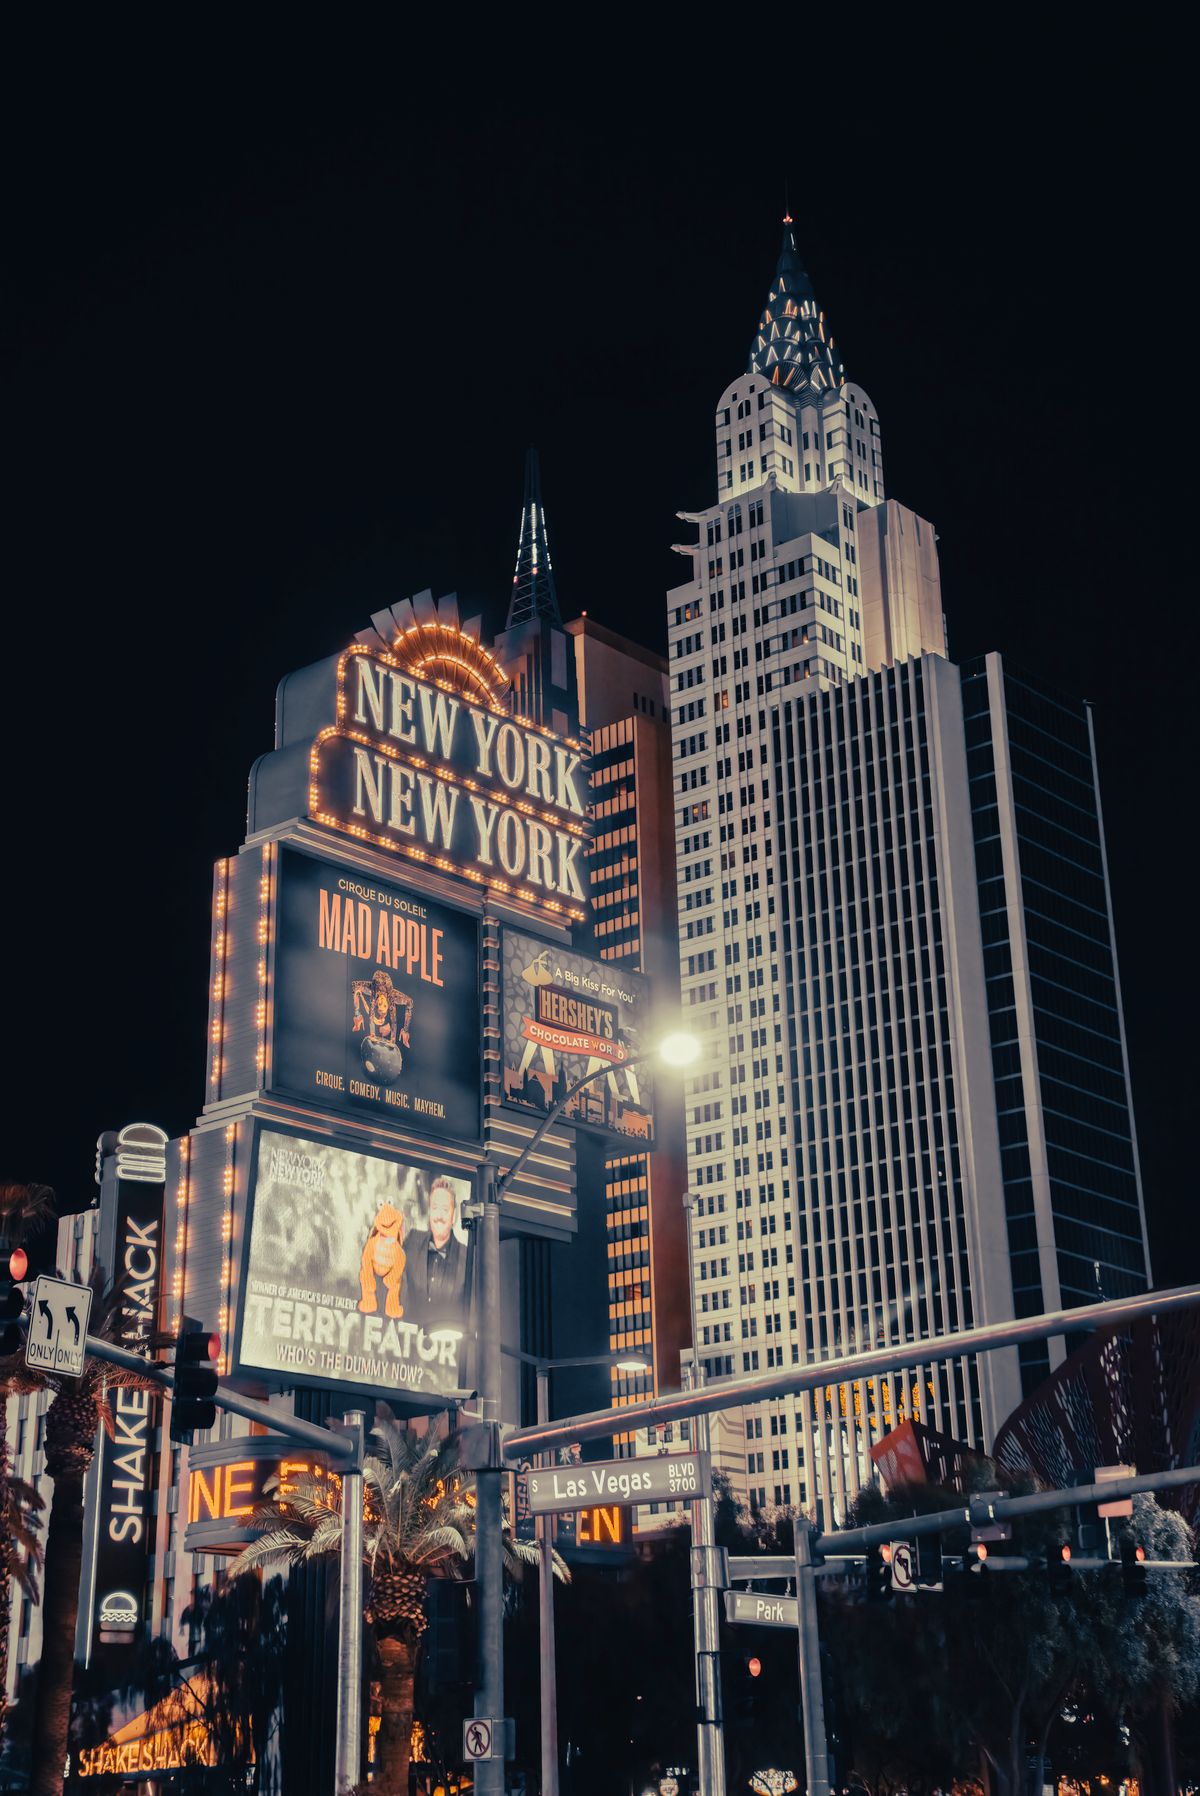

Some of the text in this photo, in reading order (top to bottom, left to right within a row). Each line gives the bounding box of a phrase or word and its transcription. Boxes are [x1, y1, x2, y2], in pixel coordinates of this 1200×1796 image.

[354, 656, 584, 816] NEW YORK
[353, 747, 586, 902] NEW YORK
[338, 879, 426, 919] CIRQUE DU SOLEIL
[319, 888, 444, 988] MAD APPLE
[555, 967, 562, 979] A
[564, 970, 579, 986] Big
[582, 976, 599, 991] Kiss
[601, 983, 615, 997] For
[541, 987, 613, 1039] HERSHEY'S
[529, 1024, 590, 1049] CHOCOLATE
[316, 1070, 446, 1119] CIRQUE. COMEDY. MUSIC. MAYHEM.
[252, 1280, 278, 1296] WINNER
[278, 1286, 287, 1297] OF
[335, 1295, 358, 1311] TALENT
[246, 1294, 457, 1367] TERRY FATOR
[29, 1343, 81, 1366] ONLY ONLY
[276, 1343, 424, 1385] WHO'S THE DUMMY NOW?
[109, 1216, 158, 1544] SHAKE HACK
[532, 1462, 695, 1499] S Las Vegas BLVD
[669, 1476, 696, 1493] 3700
[756, 1600, 784, 1622] Park
[78, 1743, 139, 1777] SHAKE
